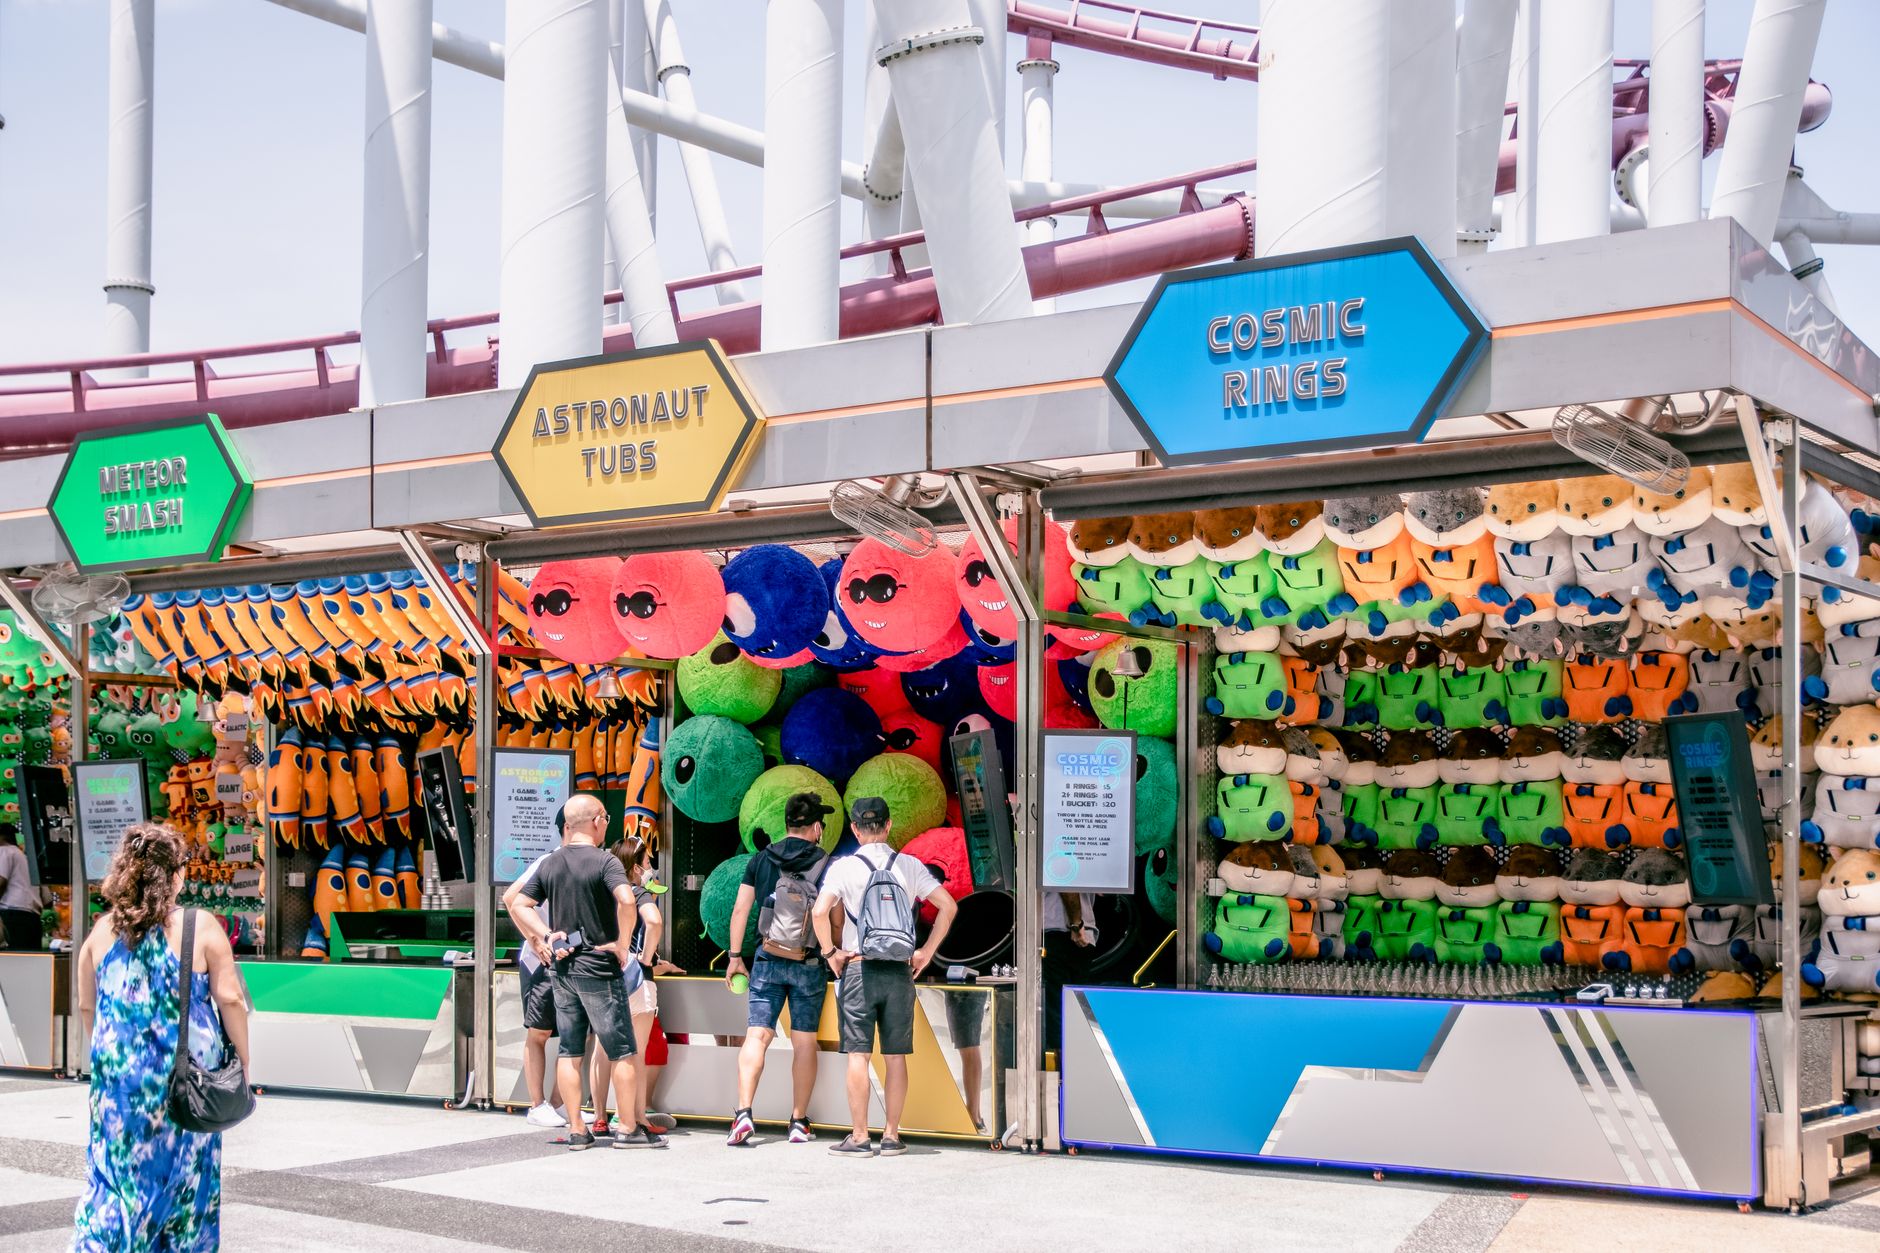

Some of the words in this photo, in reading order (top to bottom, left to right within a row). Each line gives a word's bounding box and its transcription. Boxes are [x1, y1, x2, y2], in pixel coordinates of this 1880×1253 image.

[1207, 297, 1366, 354] COSMIC
[1223, 357, 1347, 409] RINGS
[533, 384, 710, 438] ASTRONAUT
[581, 440, 657, 478] TUBS
[99, 456, 187, 494] METEOR
[104, 498, 183, 534] SMASH
[226, 723, 247, 732] GALACTIC
[1679, 742, 1722, 756] COSMIC
[1057, 754, 1118, 765] COSMIC
[1685, 755, 1720, 769] RINGS
[1063, 765, 1111, 776] RINGS
[217, 784, 240, 793] GIANT
[225, 843, 252, 855] LARGE
